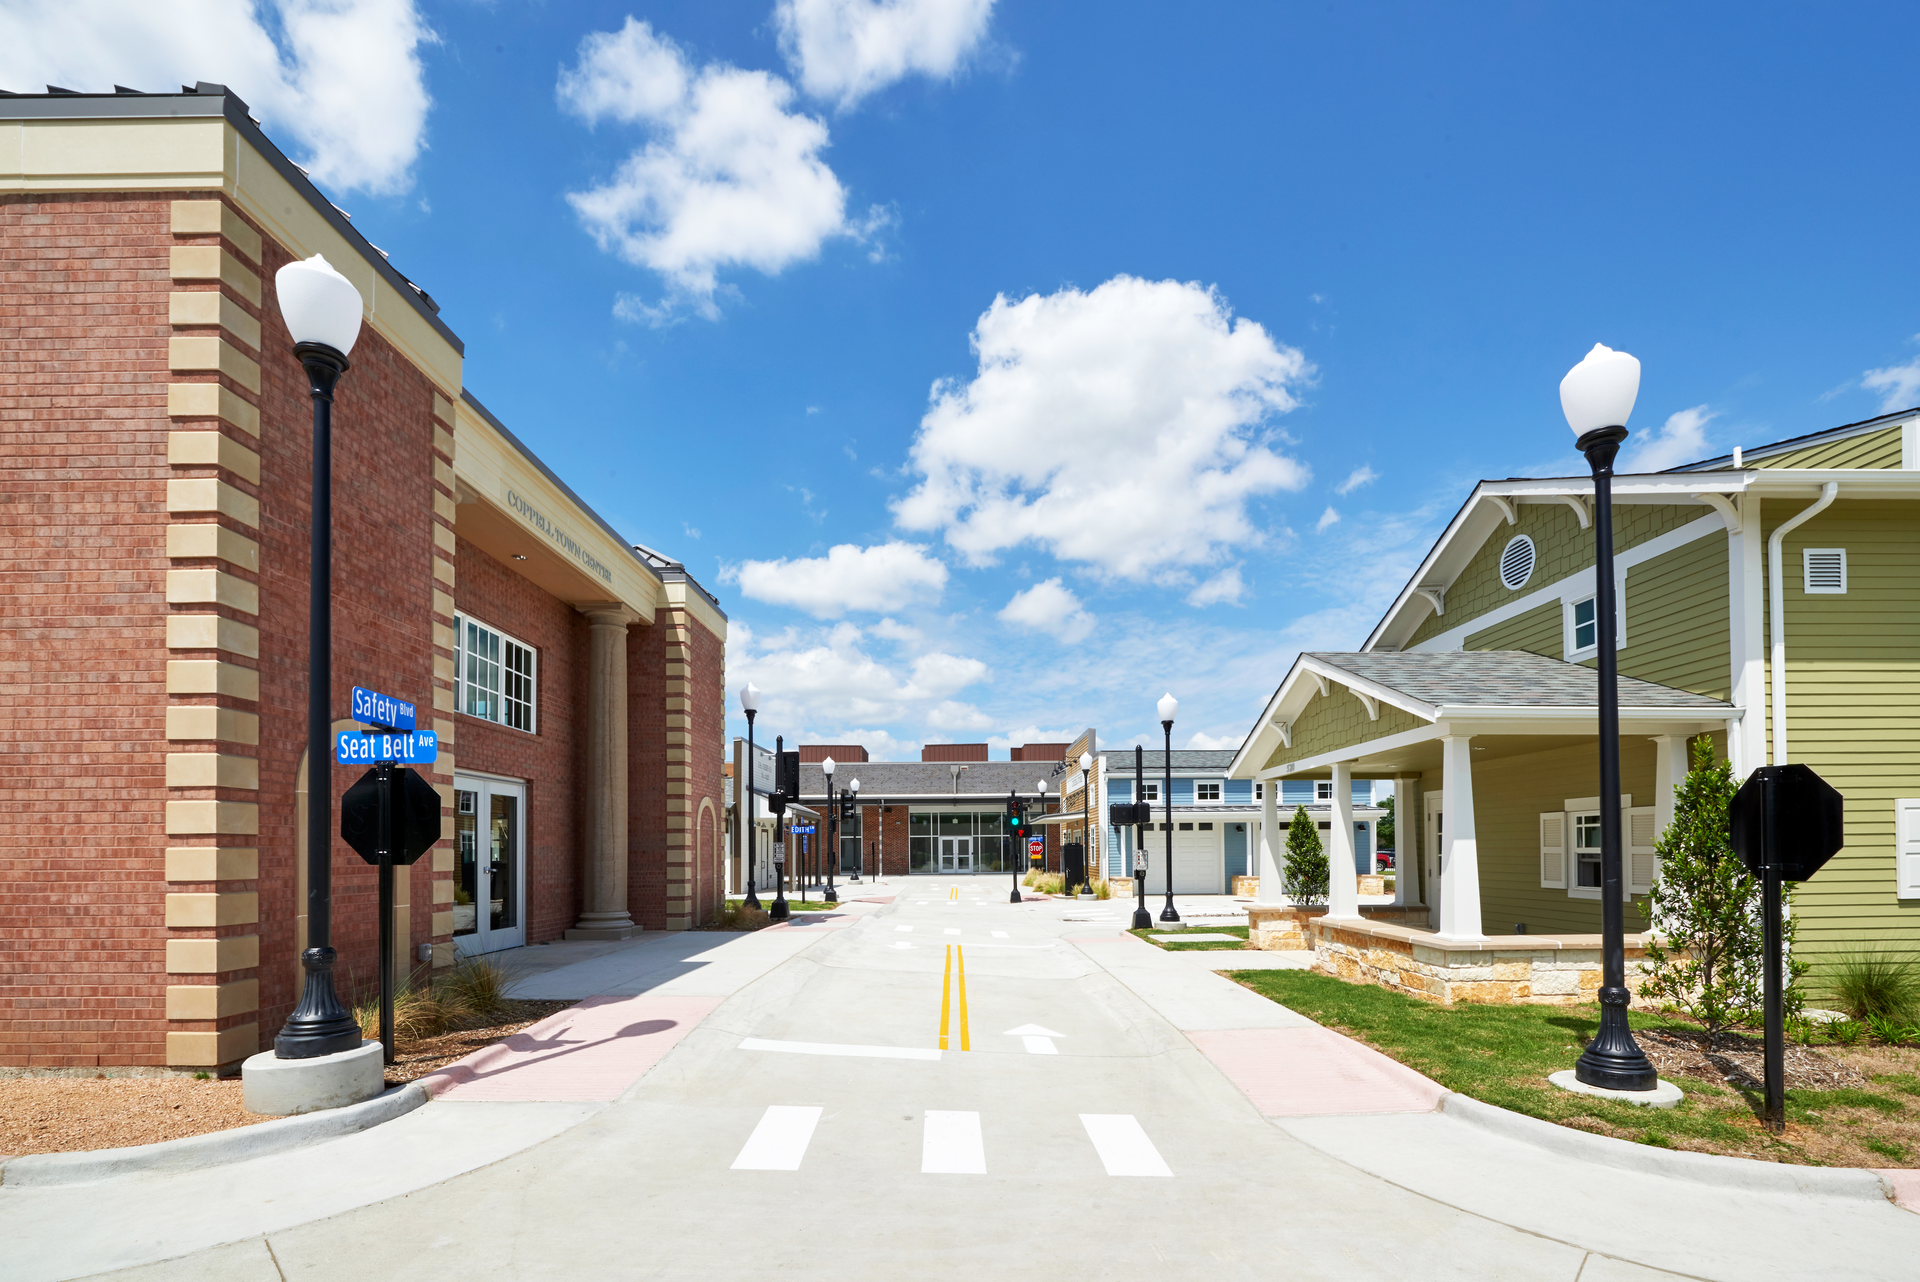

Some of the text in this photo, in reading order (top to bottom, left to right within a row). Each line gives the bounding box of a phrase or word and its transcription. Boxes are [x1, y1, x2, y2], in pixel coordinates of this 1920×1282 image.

[507, 490, 612, 583] COPPELL TOWN CENTER
[355, 689, 414, 727] Safety Blvd
[340, 734, 434, 759] Seat Belt Ave
